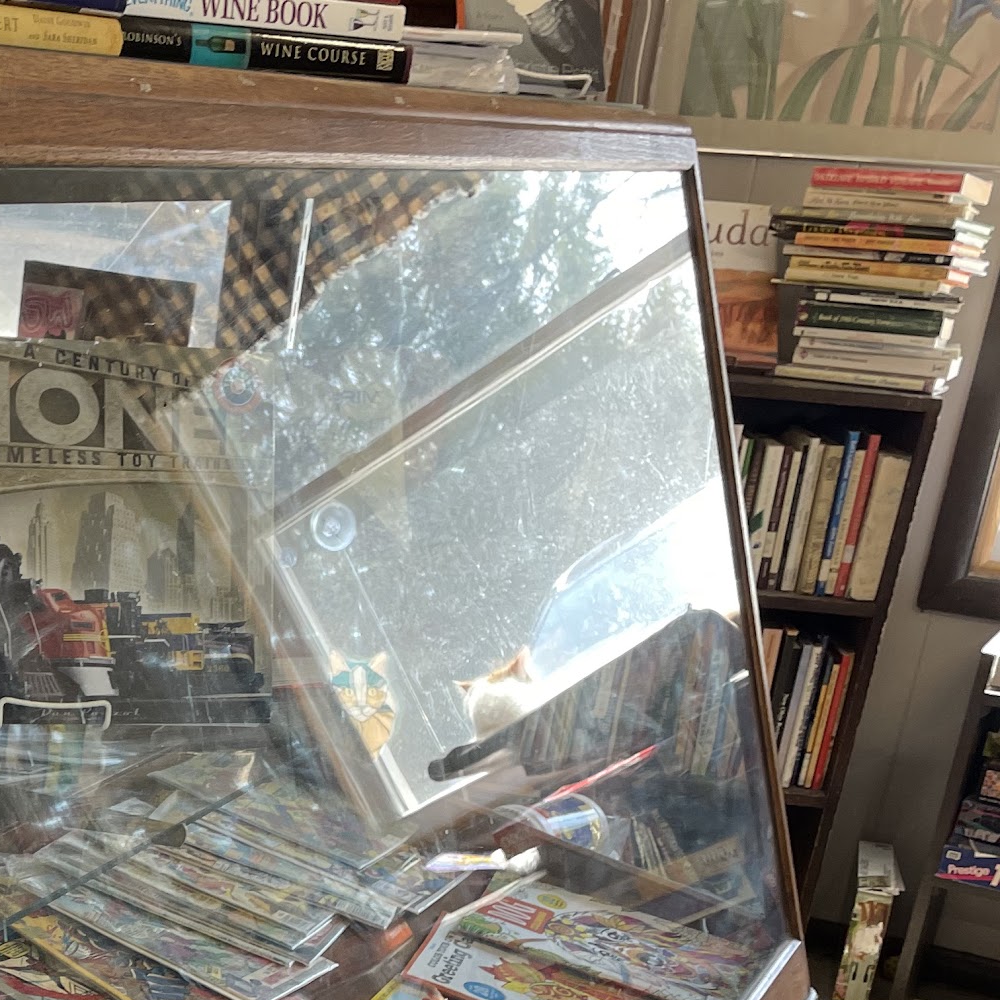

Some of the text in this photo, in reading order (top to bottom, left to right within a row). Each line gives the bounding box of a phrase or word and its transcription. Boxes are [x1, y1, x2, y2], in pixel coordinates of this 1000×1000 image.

[202, 0, 258, 21] WINE
[266, 0, 327, 29] BOOK
[260, 41, 367, 66] WINE COURSE
[23, 344, 36, 358] A
[55, 349, 159, 382] CENTURY
[117, 452, 157, 468] TOY
[431, 947, 474, 985] Greeting
